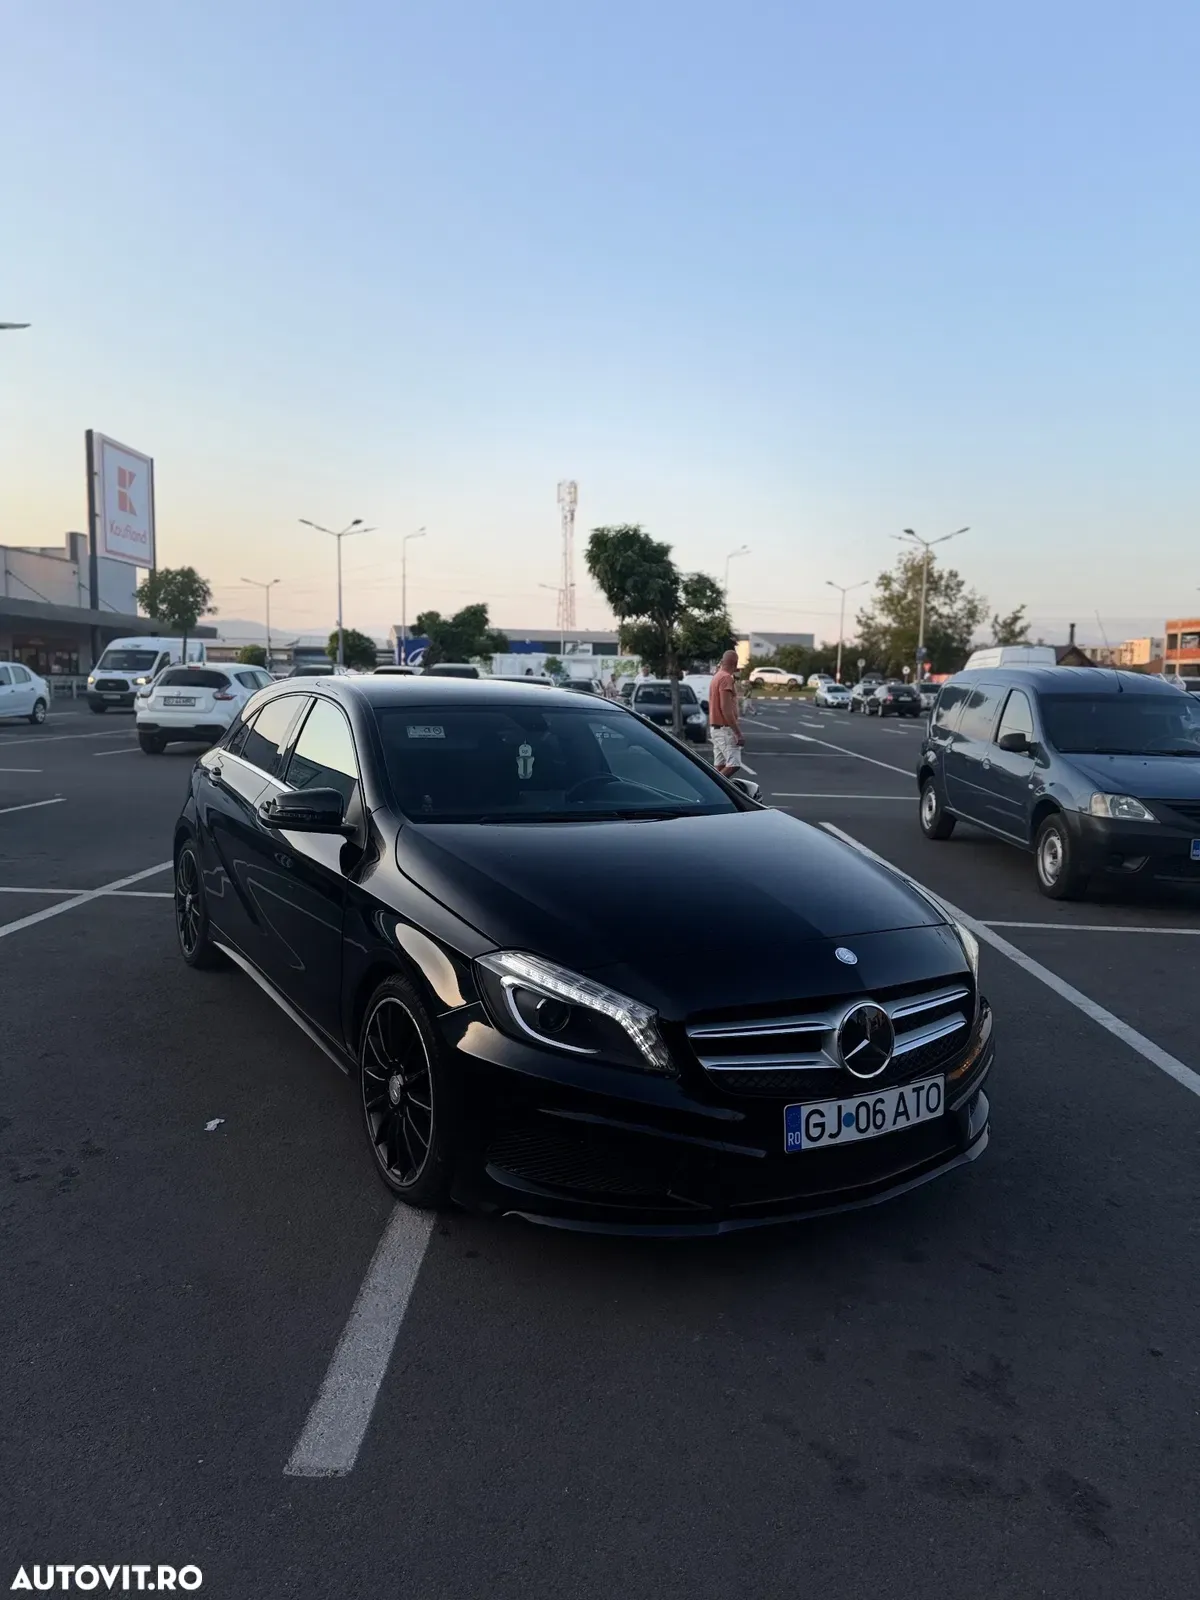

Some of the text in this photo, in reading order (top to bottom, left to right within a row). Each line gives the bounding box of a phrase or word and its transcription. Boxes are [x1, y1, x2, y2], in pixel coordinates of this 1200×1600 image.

[117, 465, 138, 517] K
[109, 520, 148, 545] Kaufland
[805, 1082, 942, 1142] GJ 06 ATO
[787, 1131, 801, 1147] RO
